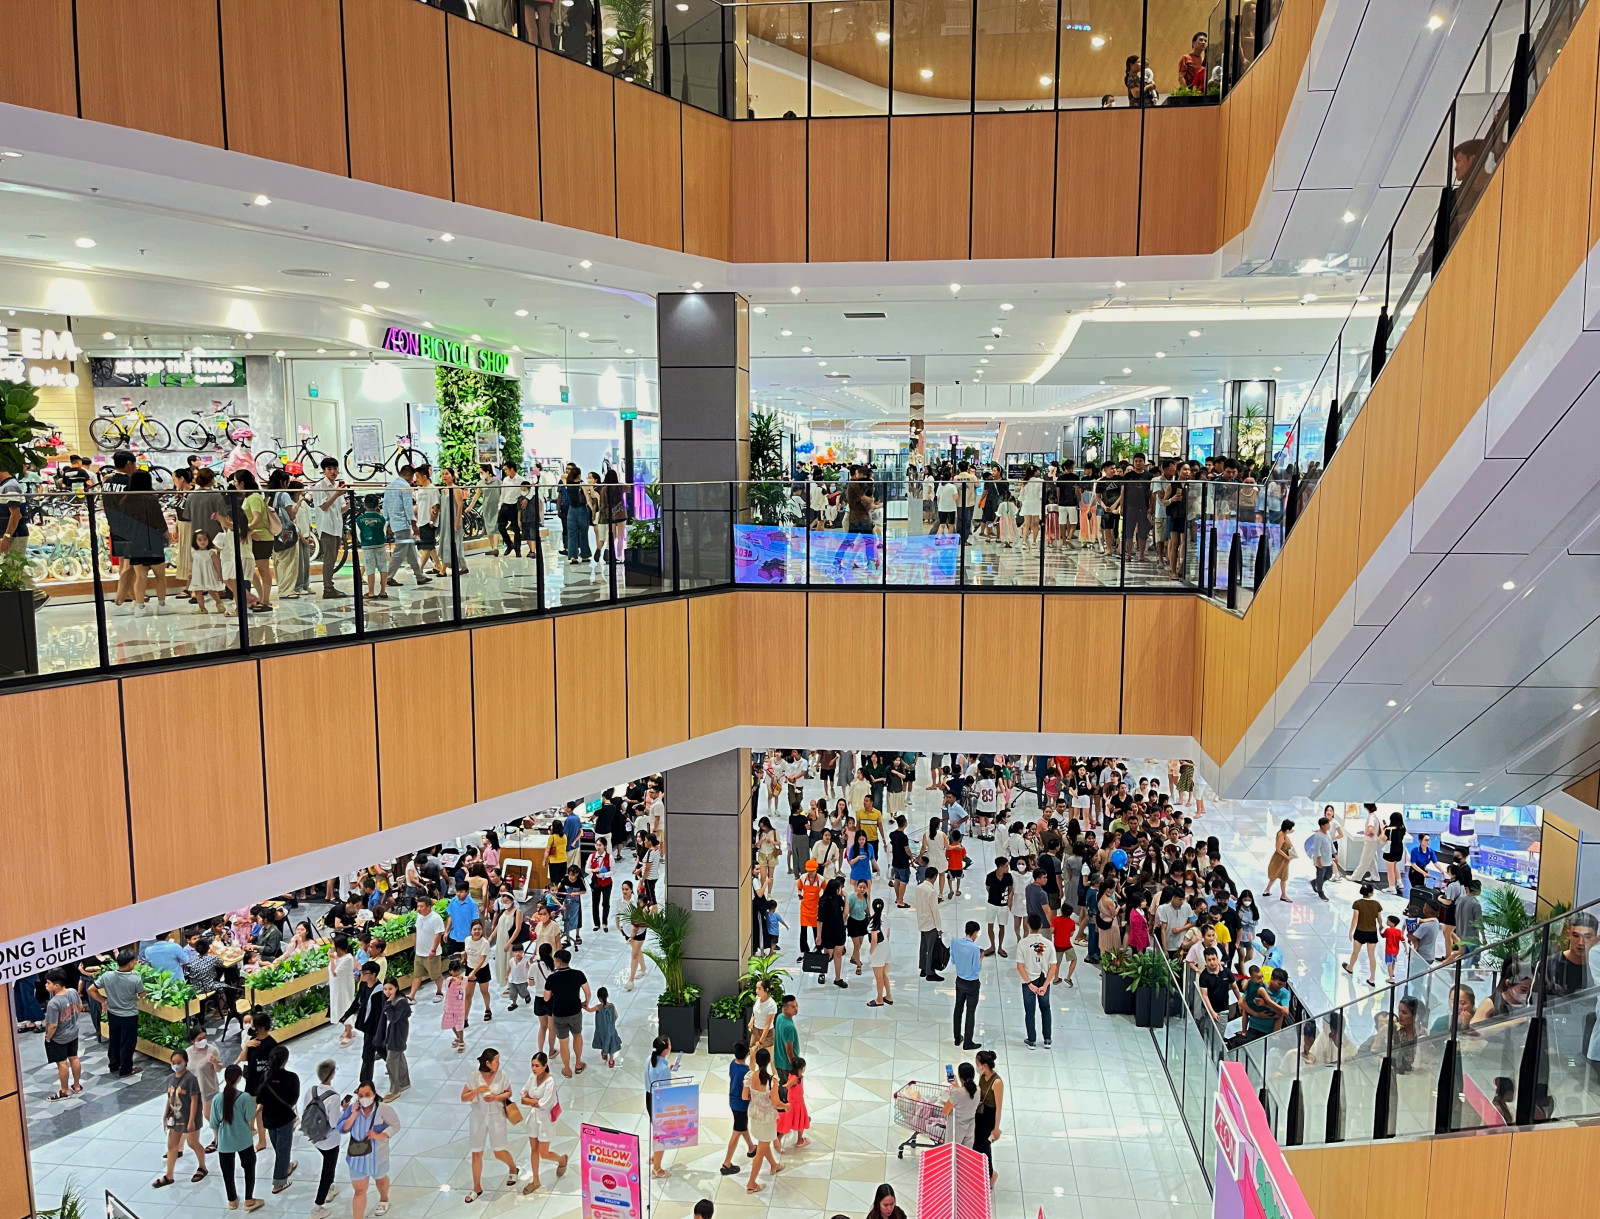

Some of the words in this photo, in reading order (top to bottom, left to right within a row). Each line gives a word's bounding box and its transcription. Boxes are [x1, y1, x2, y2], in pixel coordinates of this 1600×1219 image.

[21, 327, 77, 361] EM
[420, 333, 475, 369] BICYCLE
[478, 349, 511, 374] SHOP
[193, 361, 234, 374] THAO
[981, 788, 994, 803] 89
[42, 926, 86, 952] LIÊN
[0, 961, 32, 980] TUS
[36, 944, 86, 969] COURT
[589, 1145, 630, 1161] FOLLOW
[597, 1156, 614, 1165] AEON
